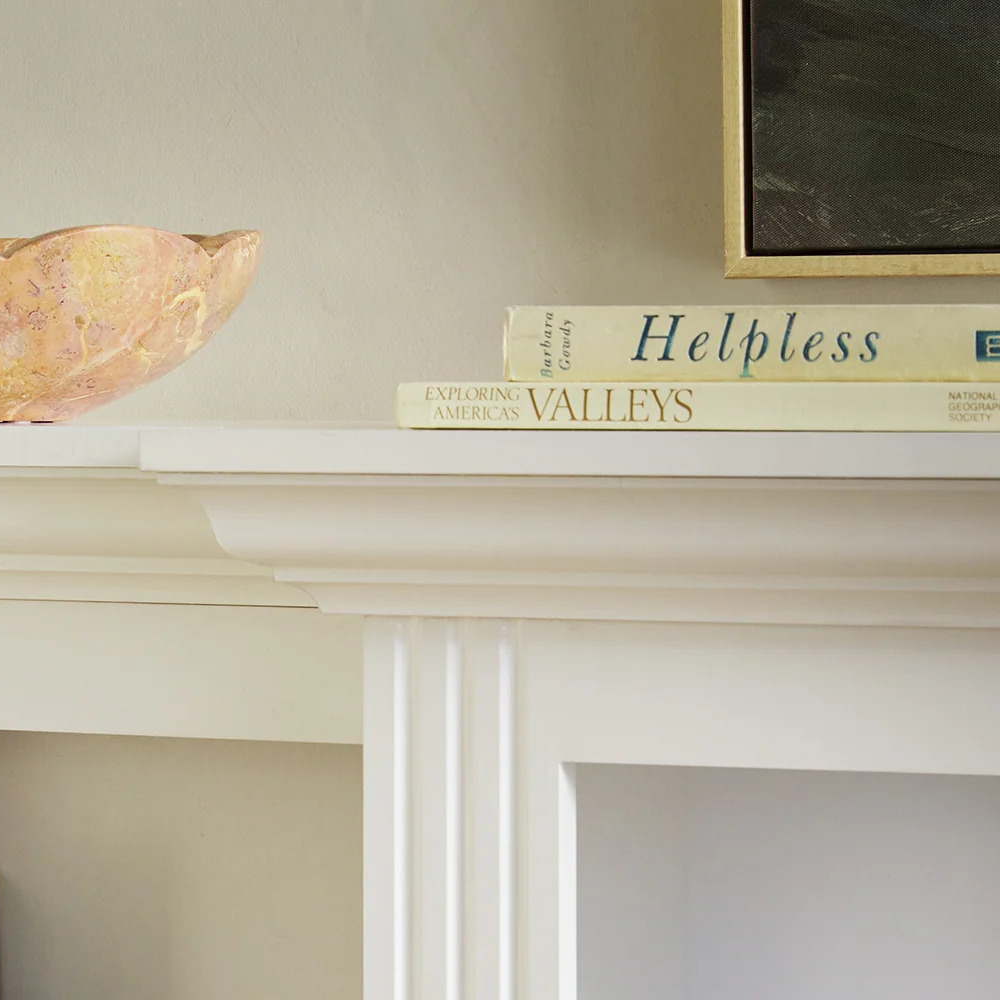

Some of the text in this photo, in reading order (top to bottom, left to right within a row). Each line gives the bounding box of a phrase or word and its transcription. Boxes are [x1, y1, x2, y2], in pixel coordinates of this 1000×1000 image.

[540, 312, 553, 377] Barbara
[559, 319, 574, 370] Gowdy
[630, 312, 880, 379] Helpless
[425, 386, 520, 401] EXPLORING
[527, 387, 693, 423] VALLEYS
[948, 391, 999, 401] NATIONAL
[433, 405, 520, 421] AMERICA'S
[948, 413, 992, 422] SOCIETY
